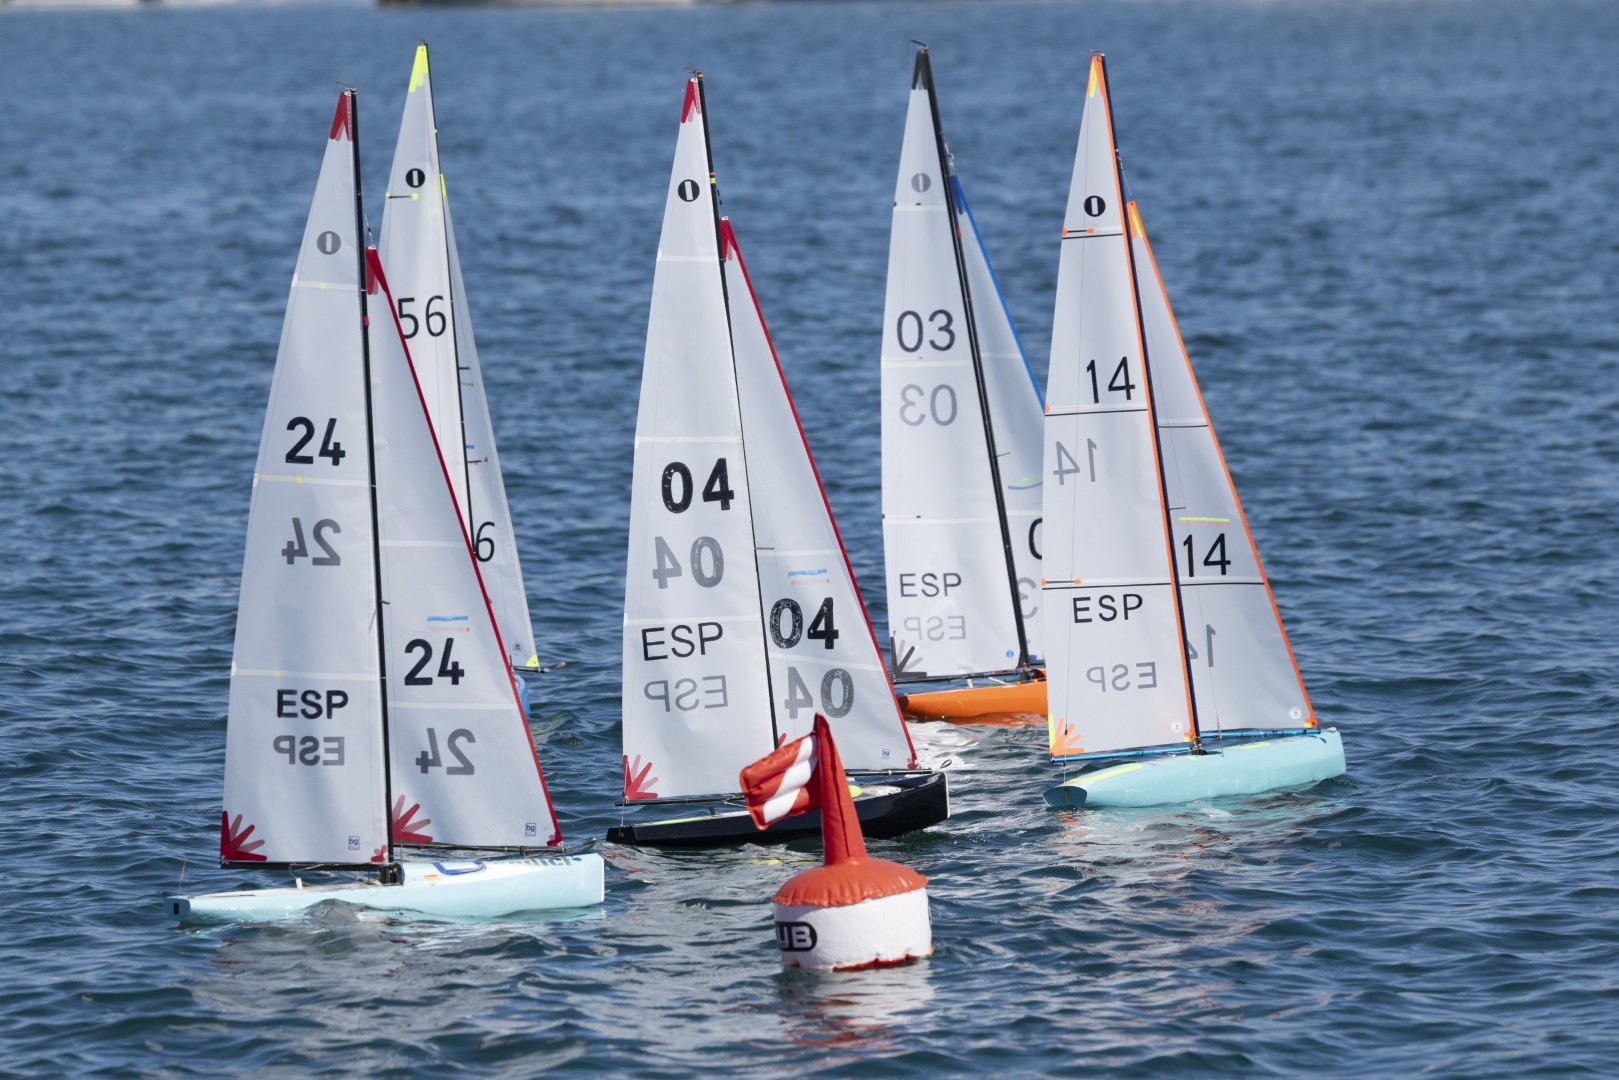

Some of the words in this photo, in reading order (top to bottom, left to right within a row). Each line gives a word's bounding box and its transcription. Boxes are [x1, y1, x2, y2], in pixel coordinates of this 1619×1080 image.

[397, 294, 447, 340] 56
[897, 309, 955, 352] 03
[1087, 357, 1135, 403] 14
[285, 417, 345, 466] 24
[662, 458, 734, 514] 04
[1183, 533, 1231, 577] 14
[900, 573, 961, 597] ESP
[770, 597, 839, 649] 04
[1073, 594, 1143, 623] ESP
[404, 638, 464, 686] 24
[642, 622, 723, 661] ESP
[277, 689, 348, 719] ESP
